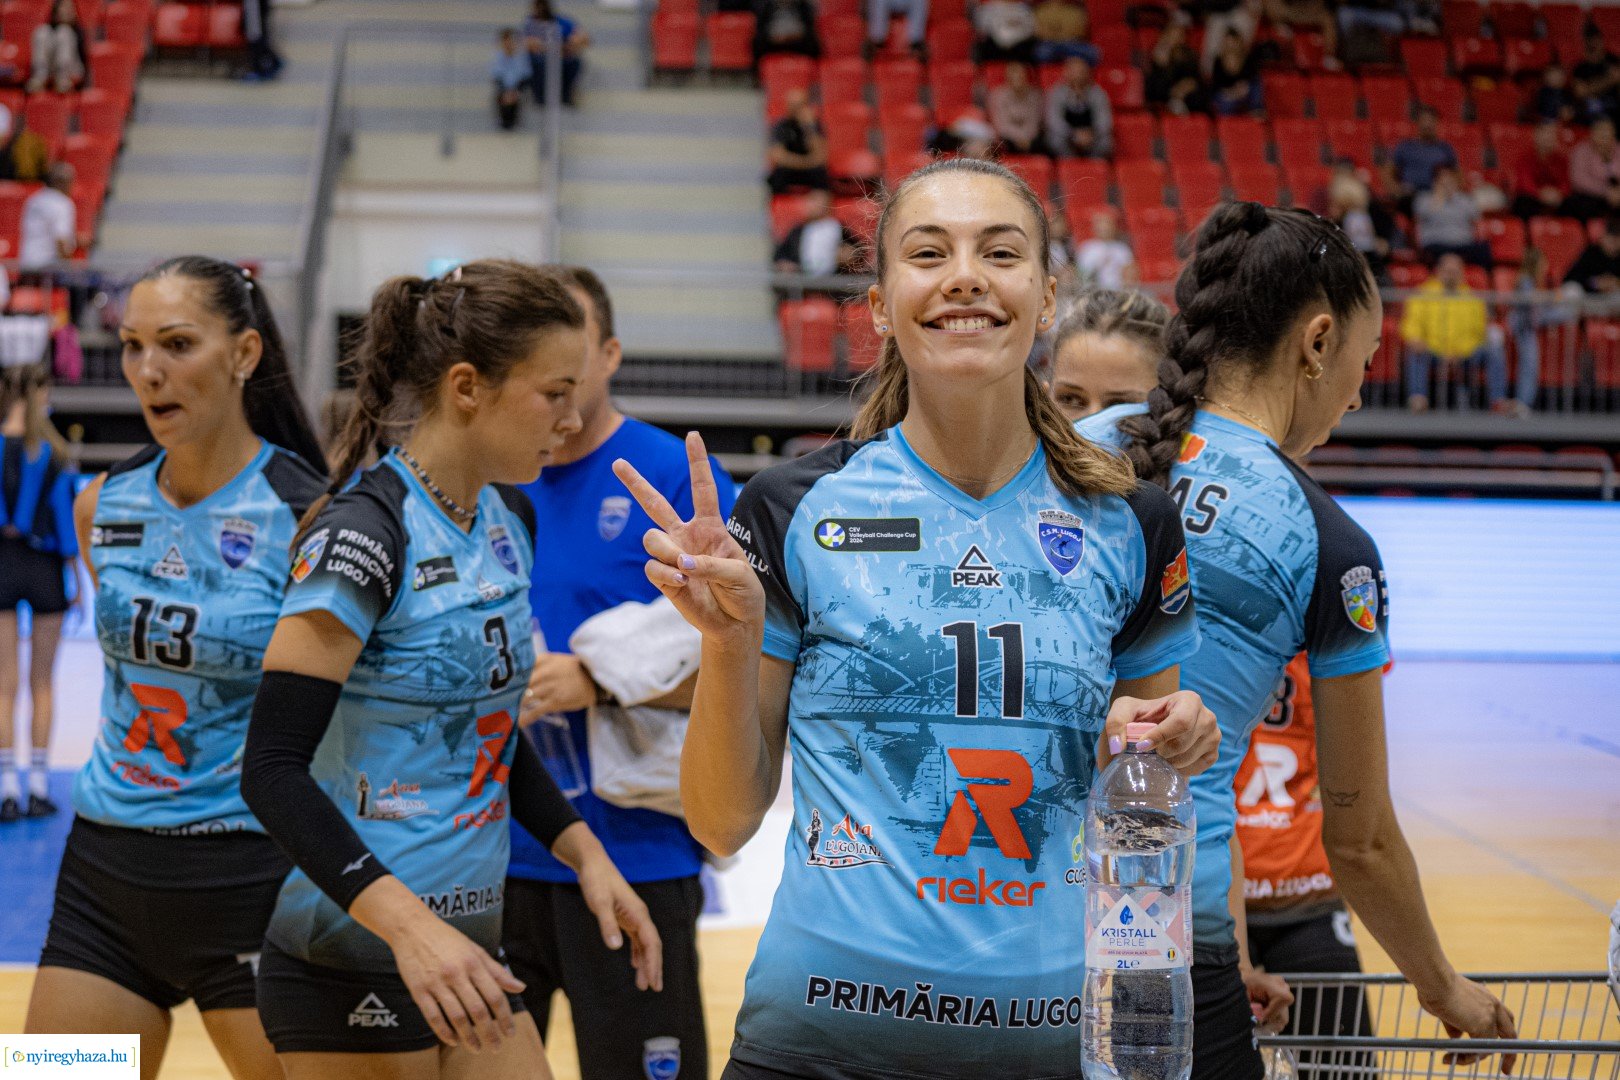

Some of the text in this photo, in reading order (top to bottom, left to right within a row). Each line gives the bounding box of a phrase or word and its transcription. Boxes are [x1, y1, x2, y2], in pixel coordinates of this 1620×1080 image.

[326, 559, 370, 587] LUGOJ
[952, 571, 1003, 588] PEAK
[132, 597, 200, 669] 13
[484, 615, 517, 694] 3
[941, 620, 1025, 720] 11
[125, 683, 188, 767] R
[1240, 742, 1298, 807] R
[933, 748, 1034, 860] R
[825, 840, 884, 858] LUGOJAN
[916, 867, 1046, 907] rieker
[1101, 927, 1157, 938] KRISTALL
[1110, 938, 1145, 947] PERLE
[348, 1013, 400, 1027] PEAK
[806, 975, 1000, 1029] PRIMĂRIA
